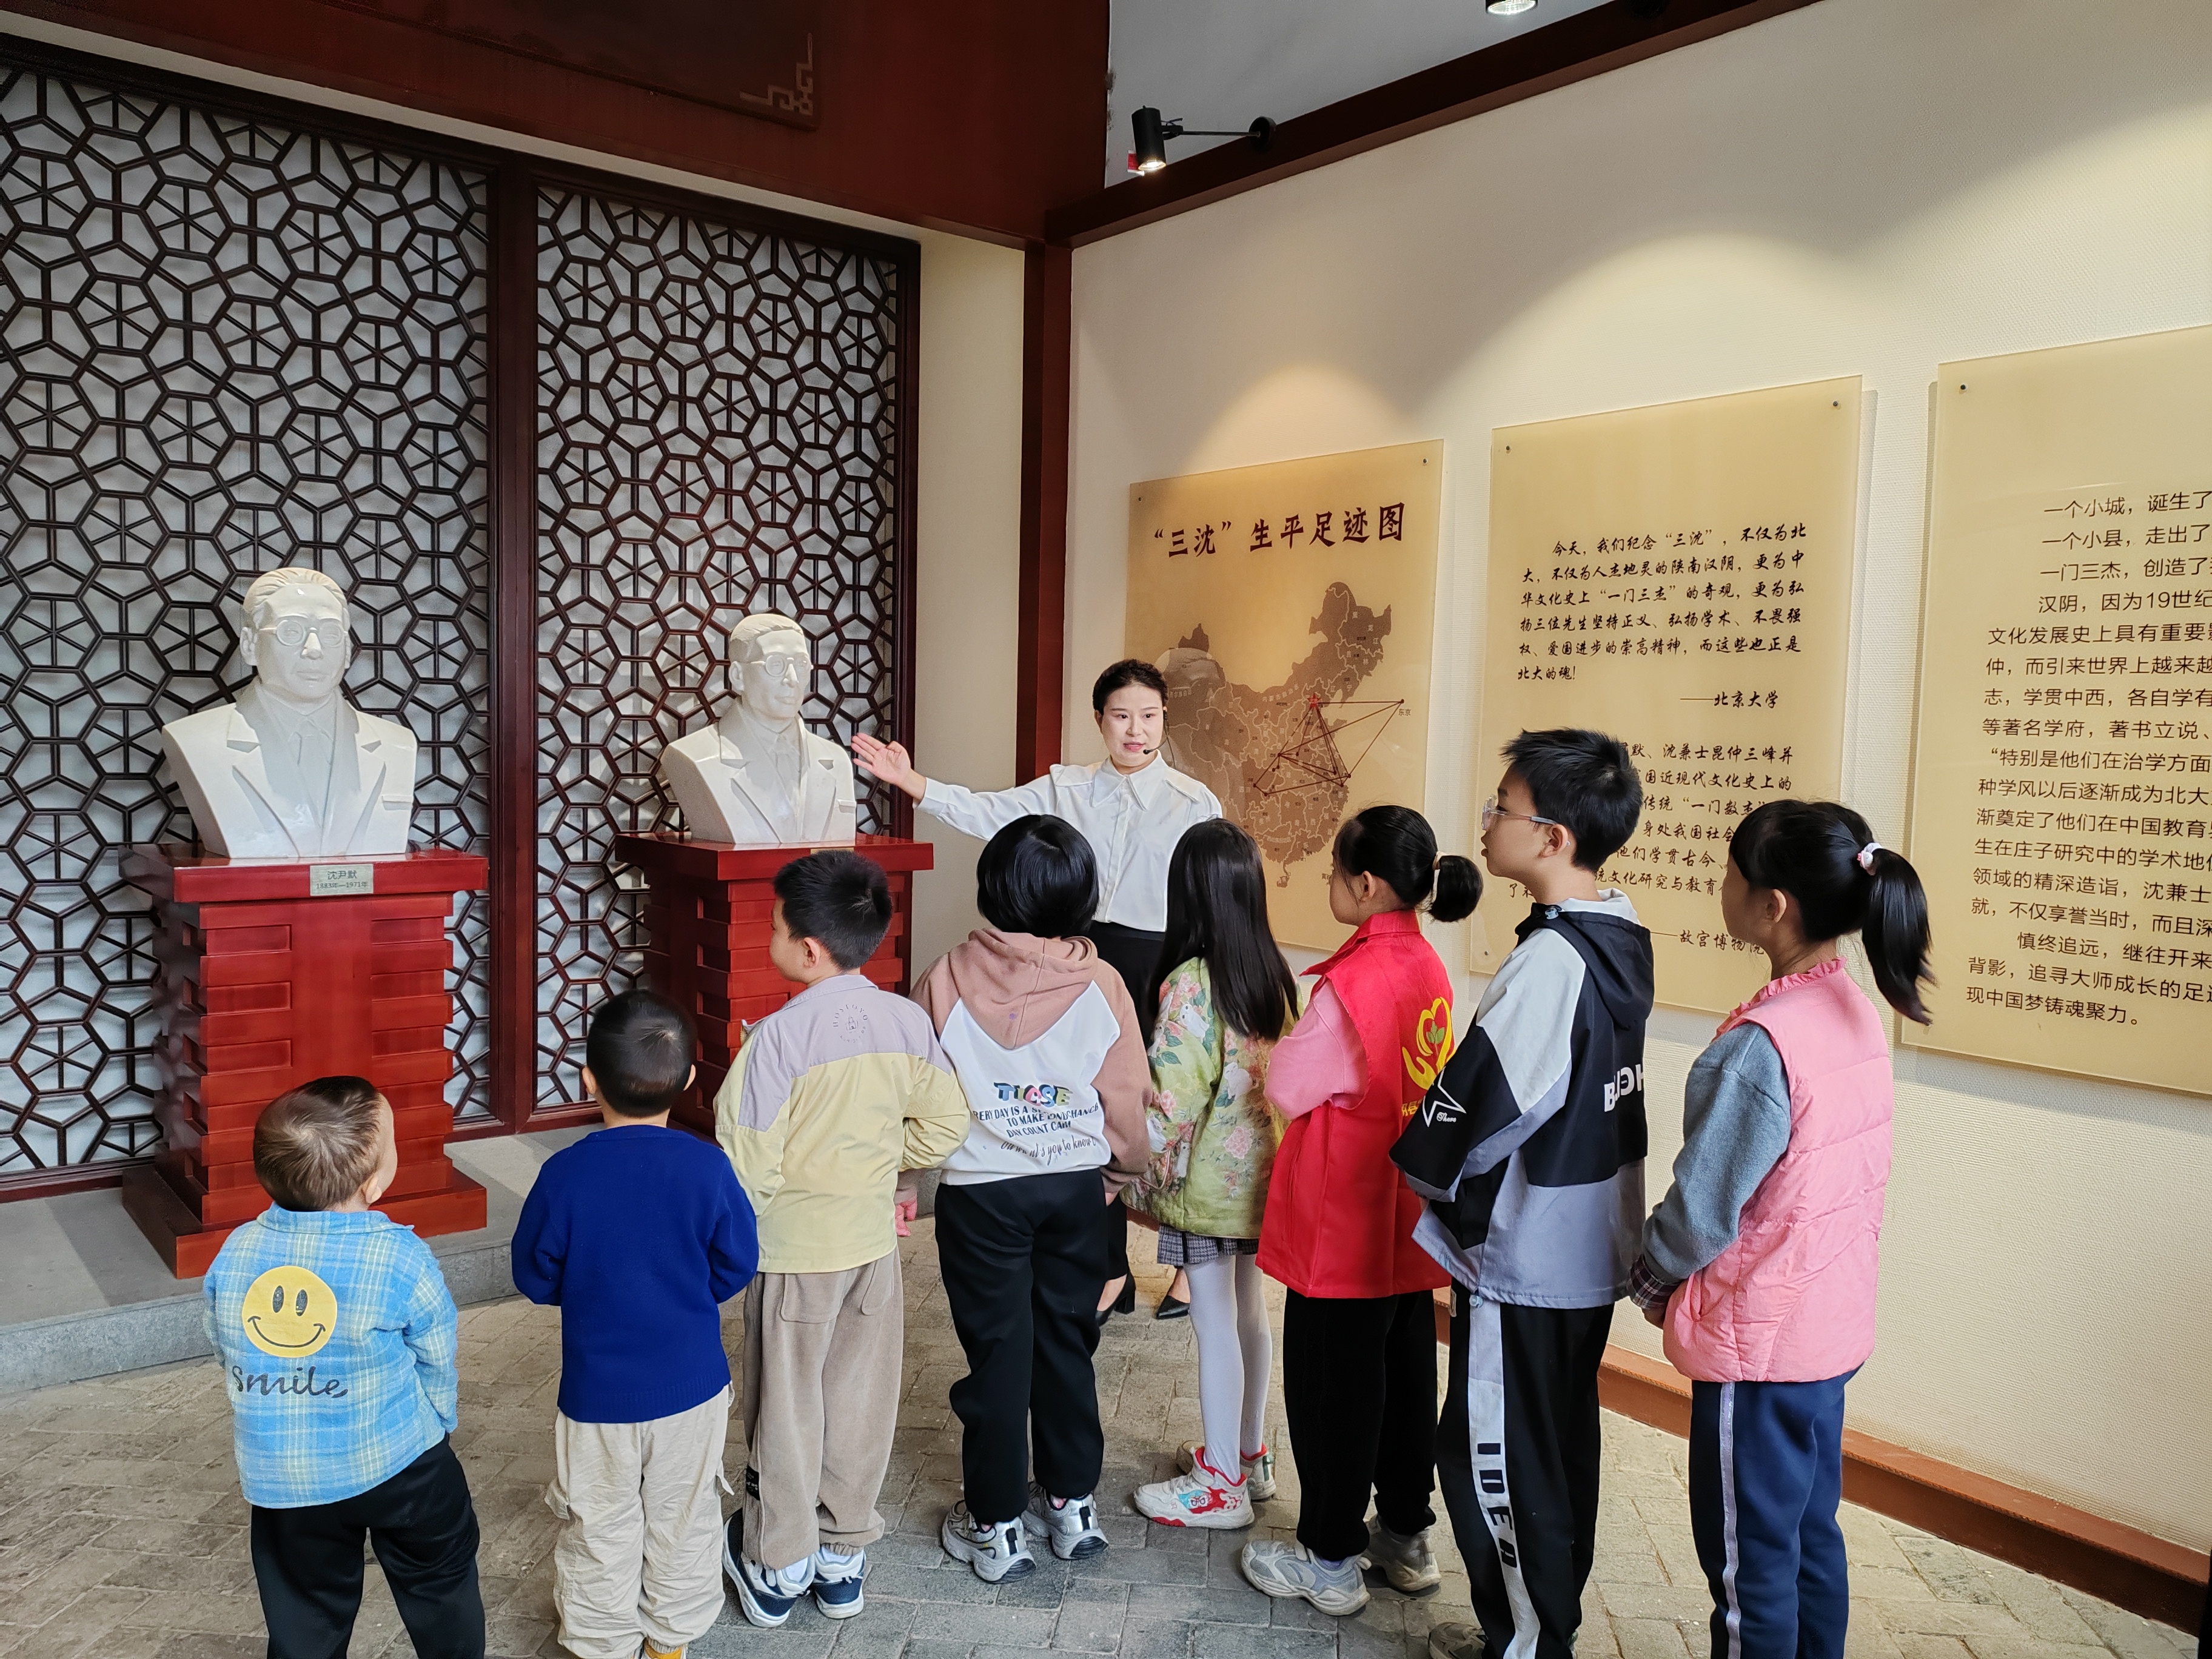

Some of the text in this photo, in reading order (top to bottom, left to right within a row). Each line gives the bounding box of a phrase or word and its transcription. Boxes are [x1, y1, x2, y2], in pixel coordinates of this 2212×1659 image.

[2044, 491, 2212, 518] 一个小城，诞生了
[2042, 523, 2211, 551] 一个小县，走出了
[2039, 557, 2212, 582] 一门三杰，创造了
[2038, 589, 2212, 614] 汉阴，因为19世纪
[1987, 622, 2212, 645] 文化发展史上具有重要
[1621, 742, 1794, 765] 默、沈兼士昆仲三峰并
[1637, 769, 1792, 791] 国近现代文化史上的
[1976, 808, 2212, 839] 渐奠定了他们在中国教育
[1974, 838, 2212, 872] 生在庄子研究中的学术地
[1595, 868, 1722, 896] 统文化研究与教育
[1968, 956, 2212, 1004] 背影，追寻大师成长的足
[994, 1107, 1009, 1119] DAY
[1011, 1105, 1020, 1117] IS
[1022, 1105, 1028, 1115] A
[1006, 1113, 1045, 1128] TO MAKE
[1006, 1128, 1023, 1138] DAY
[1022, 1123, 1049, 1136] COUNT
[232, 1365, 349, 1398] Smile
